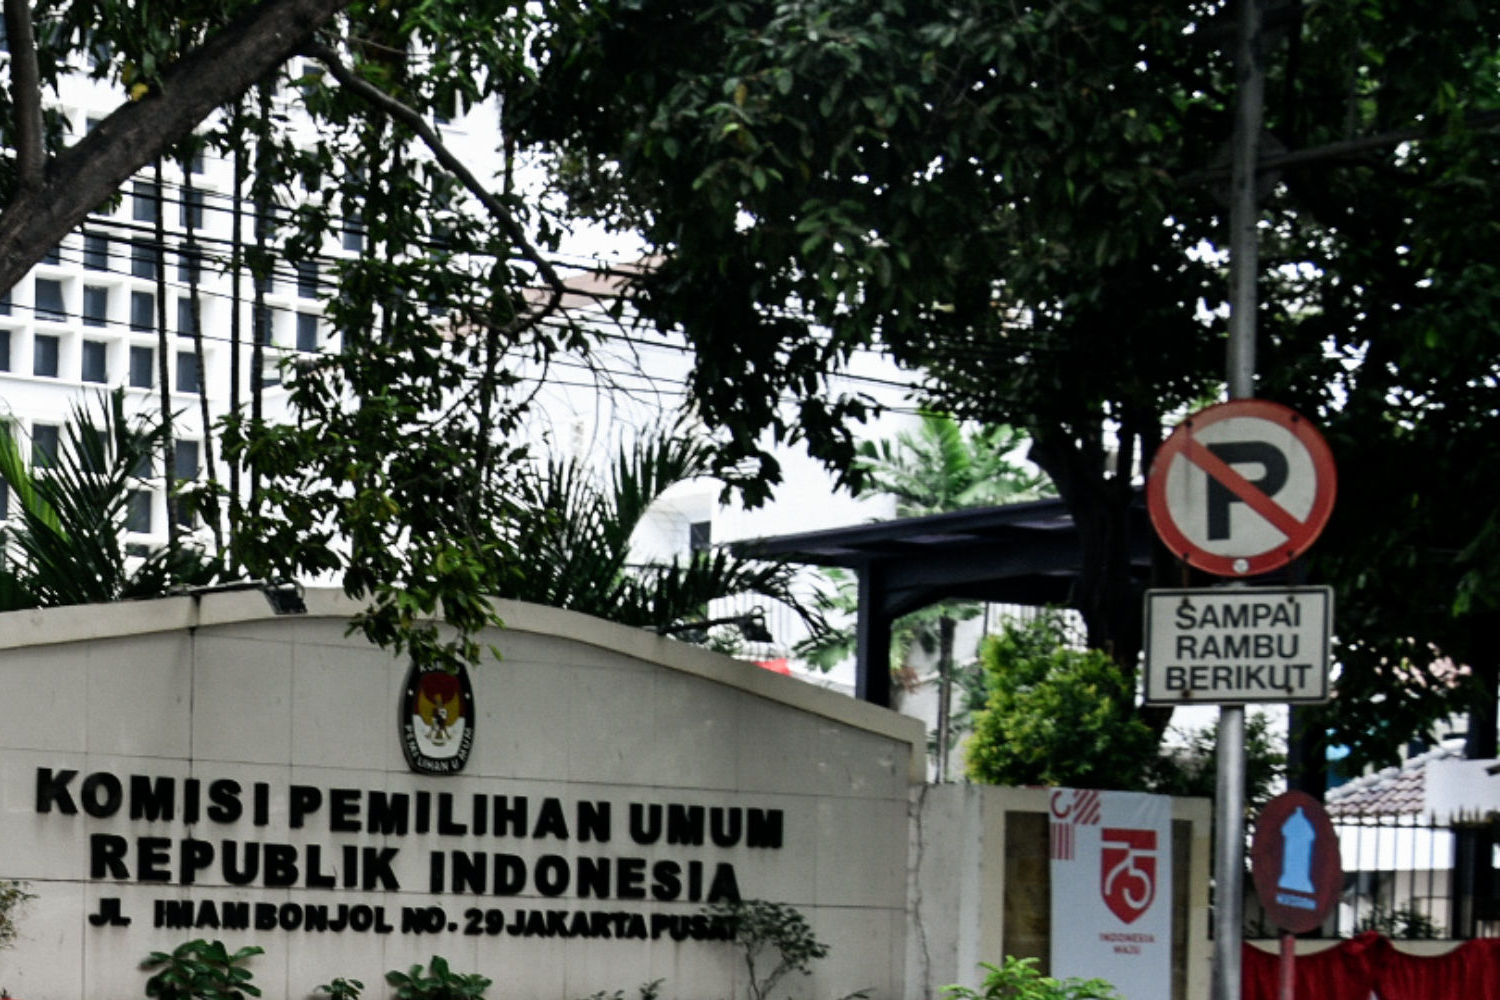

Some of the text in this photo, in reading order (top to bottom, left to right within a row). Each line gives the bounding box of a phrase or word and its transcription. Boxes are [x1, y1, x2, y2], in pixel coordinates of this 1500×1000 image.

[1175, 603, 1300, 630] SAMPAI
[1176, 634, 1299, 659] RAMBU
[1165, 664, 1312, 690] BERIKUT
[36, 767, 784, 848] KOMISI PEMILIHAN UMUM
[90, 833, 741, 903] REPUBLIK INDONESIA
[88, 898, 739, 941] JL IMAM BONJOL NO. 29 JAKARTA PUSAT
